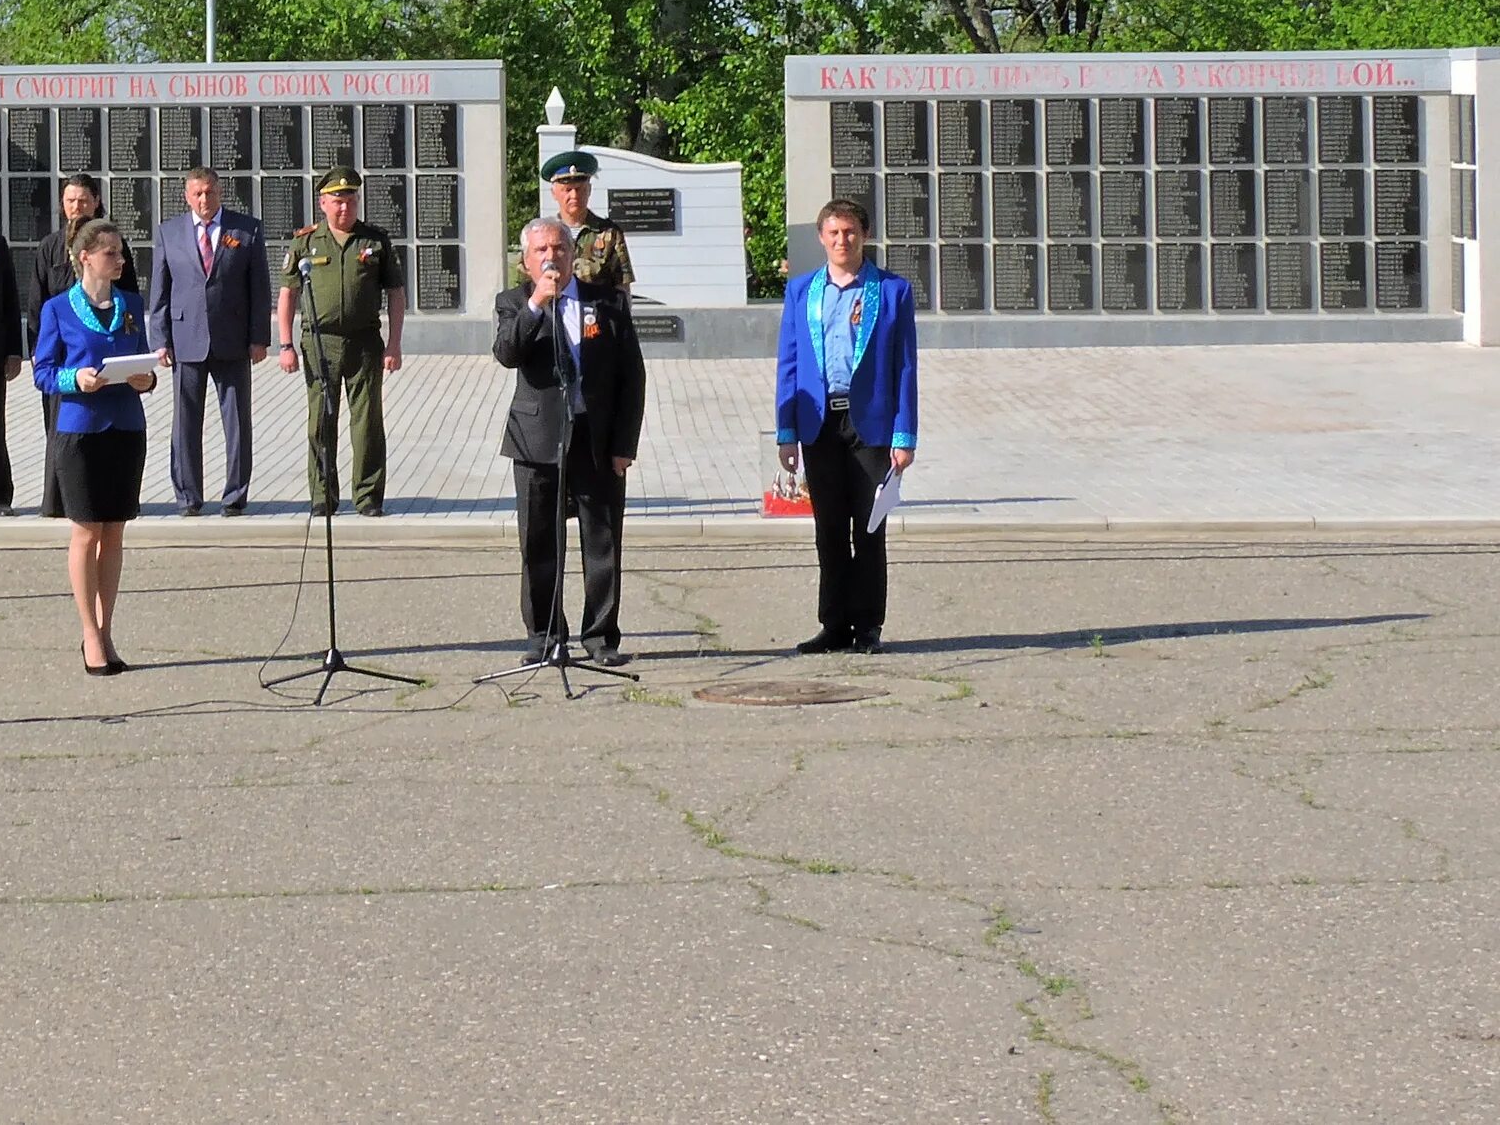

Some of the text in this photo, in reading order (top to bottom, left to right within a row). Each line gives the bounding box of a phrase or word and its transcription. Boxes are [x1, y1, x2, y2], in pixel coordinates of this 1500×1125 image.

[15, 75, 117, 100] СМОТРИТ
[129, 75, 159, 98] НА
[168, 74, 248, 98] СЫНОВ
[258, 74, 332, 96] СВОИХ
[343, 73, 431, 95] РОССИЯ
[820, 66, 877, 90] КАК
[886, 65, 975, 92] БУДТО
[1079, 64, 1164, 89] ВРА
